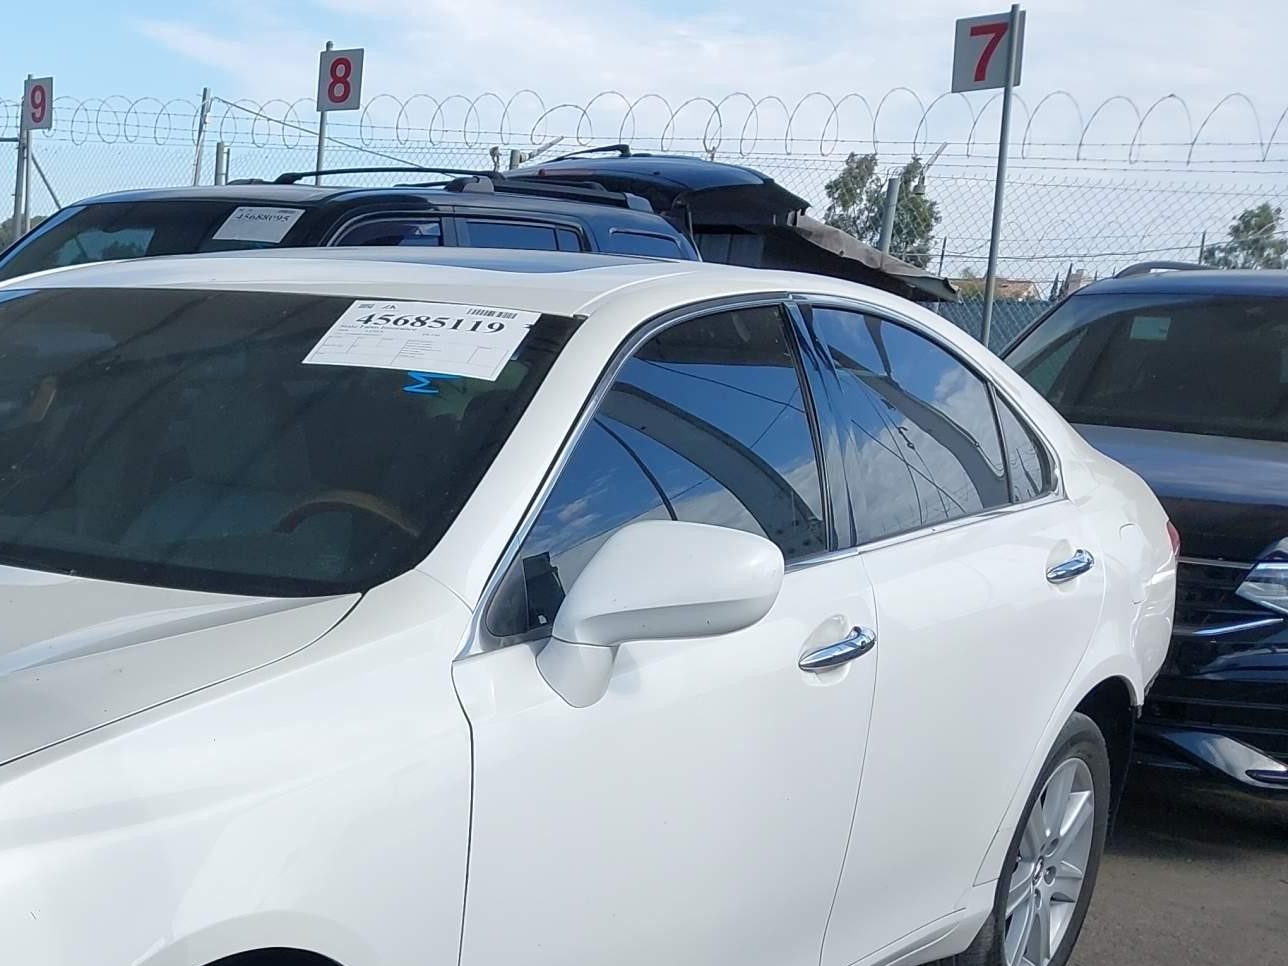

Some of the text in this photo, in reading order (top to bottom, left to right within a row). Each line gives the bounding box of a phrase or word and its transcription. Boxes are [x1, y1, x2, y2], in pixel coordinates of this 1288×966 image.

[969, 22, 1009, 82] 7
[328, 57, 352, 103] 8
[30, 85, 46, 123] 9
[356, 313, 505, 334] 45685119
